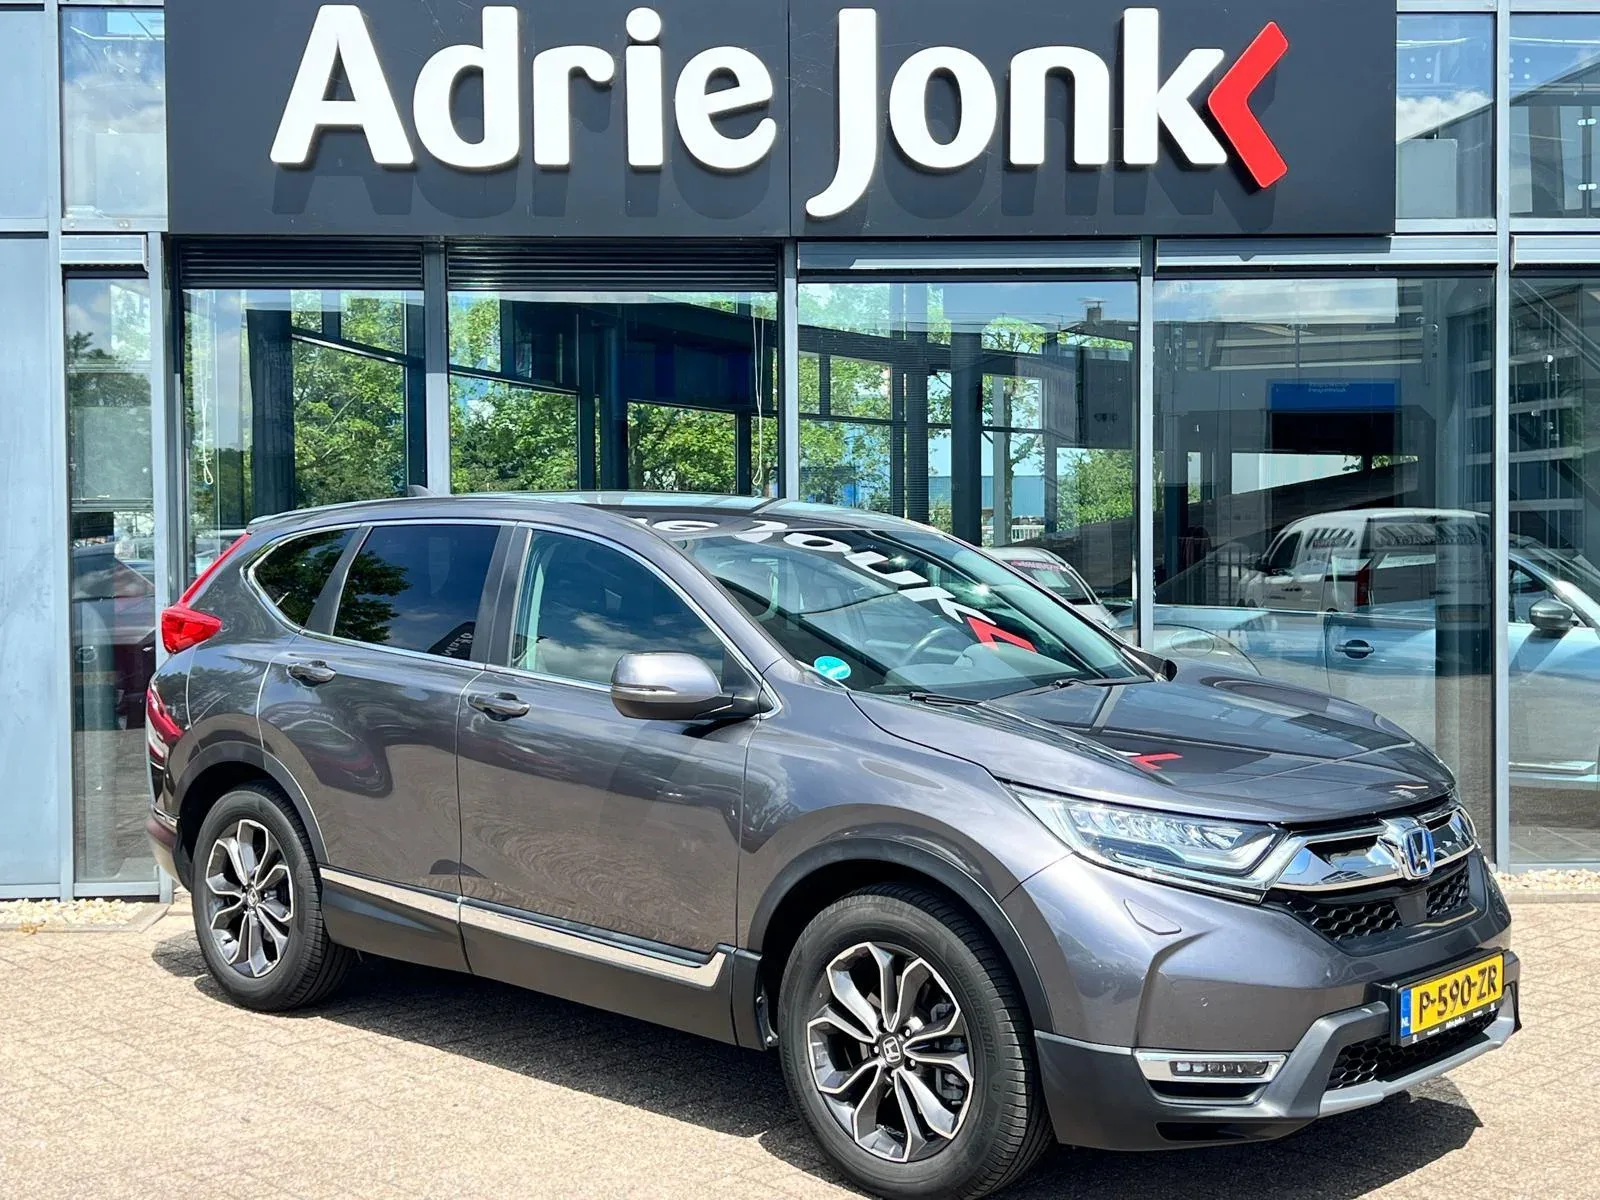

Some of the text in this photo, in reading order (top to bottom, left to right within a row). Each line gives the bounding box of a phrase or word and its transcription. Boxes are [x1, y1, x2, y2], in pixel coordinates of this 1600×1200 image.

[268, 4, 1229, 218] Adrie Jonk
[1400, 1017, 1411, 1029] NL
[1418, 964, 1498, 1025] P-590-ZR
